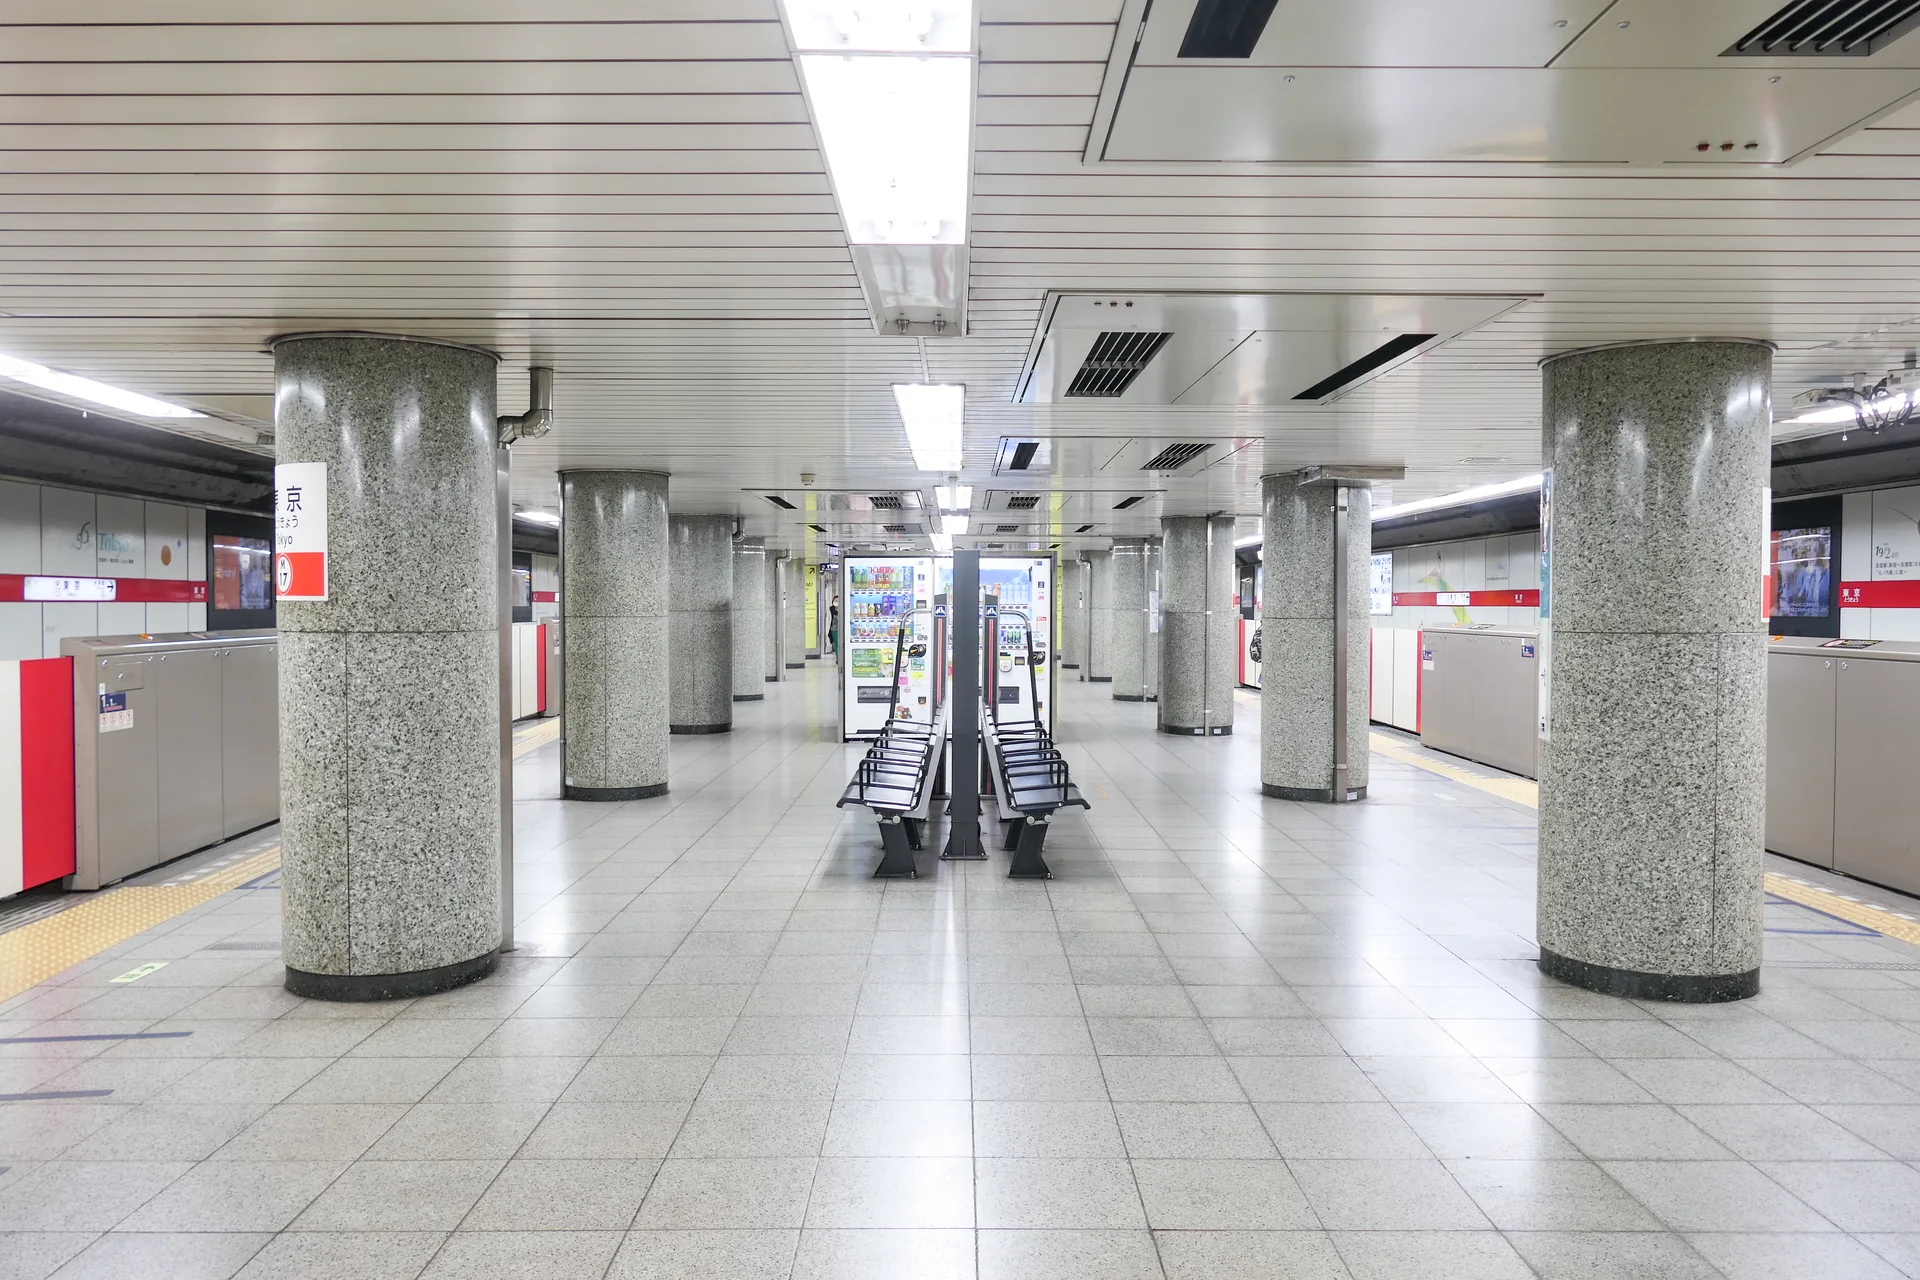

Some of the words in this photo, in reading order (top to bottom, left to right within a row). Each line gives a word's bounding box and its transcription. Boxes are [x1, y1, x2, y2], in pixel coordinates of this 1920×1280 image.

[275, 485, 302, 513] 京
[276, 533, 293, 549] okyo
[280, 558, 286, 569] M
[870, 566, 894, 574] KIRIN
[280, 572, 288, 586] 17
[1842, 588, 1861, 597] 東京
